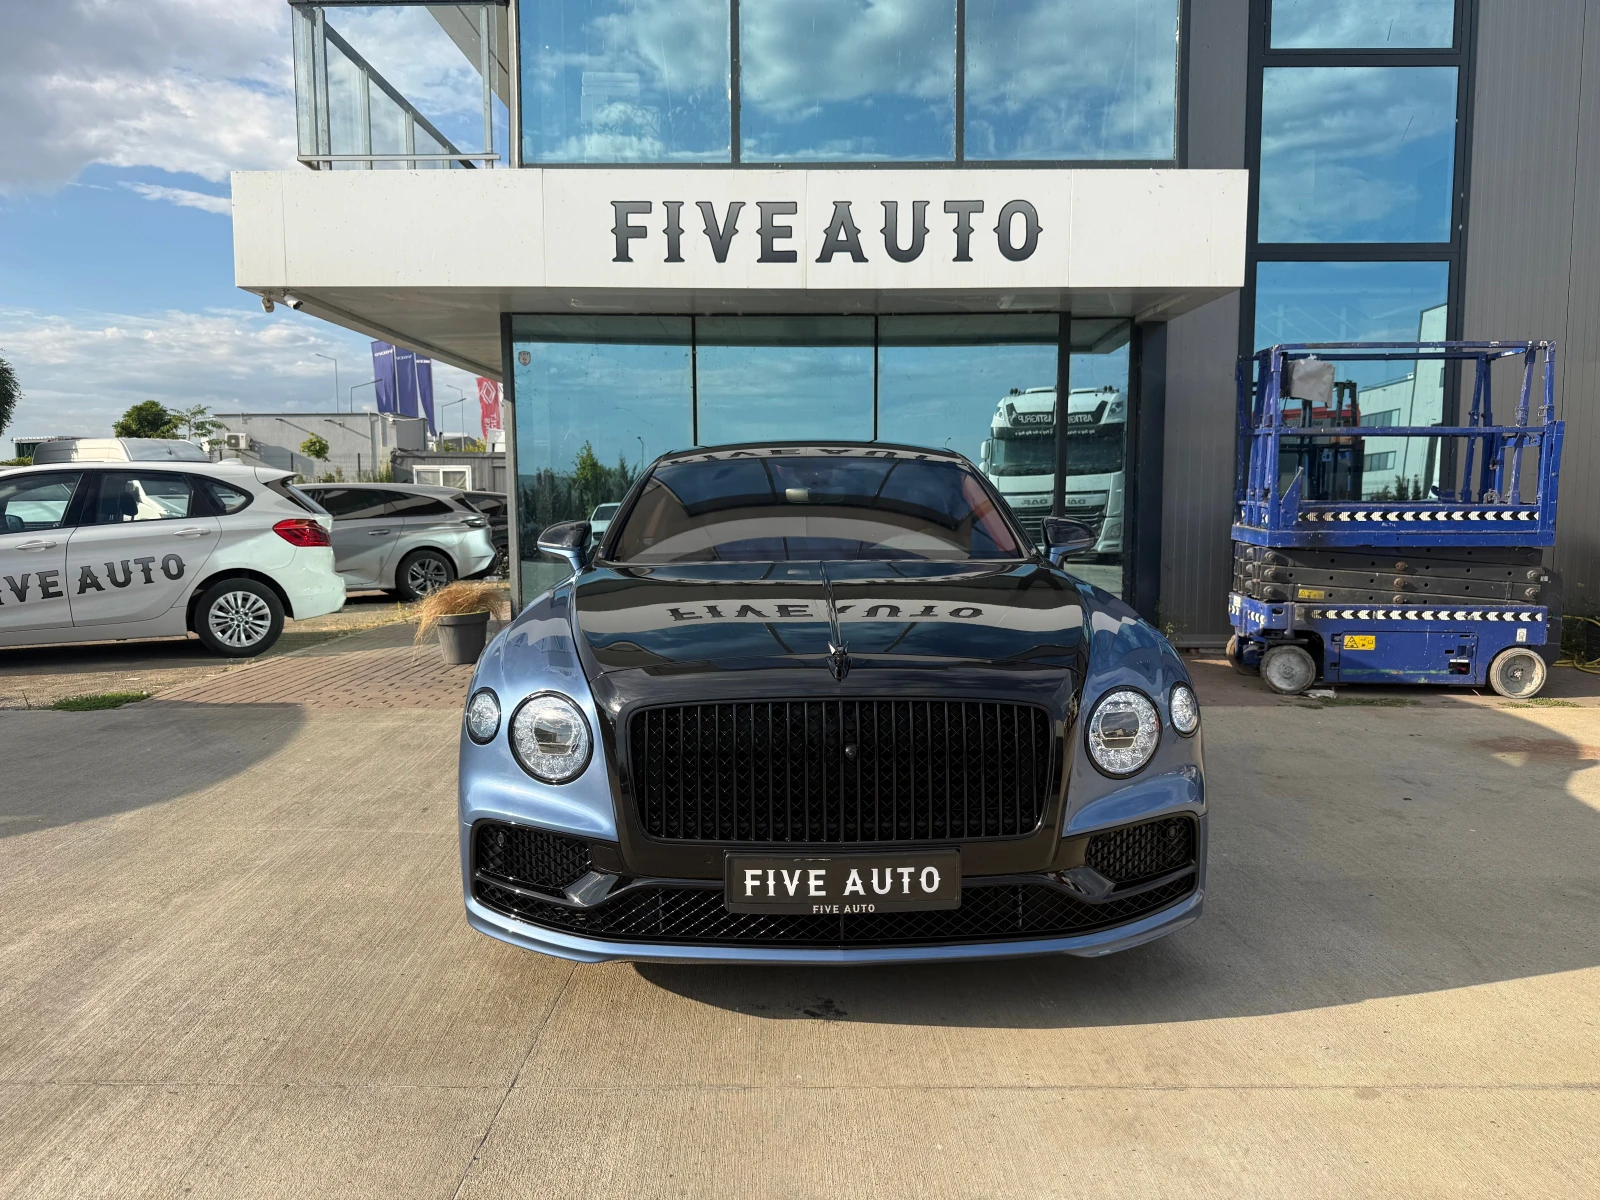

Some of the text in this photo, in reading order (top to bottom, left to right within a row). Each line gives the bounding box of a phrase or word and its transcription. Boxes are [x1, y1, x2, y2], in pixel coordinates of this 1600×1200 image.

[610, 200, 1043, 263] FIVE AUTO
[77, 553, 186, 595] AUTO
[743, 866, 941, 897] FIVE AUTO
[812, 903, 876, 914] FIVE AUTO
